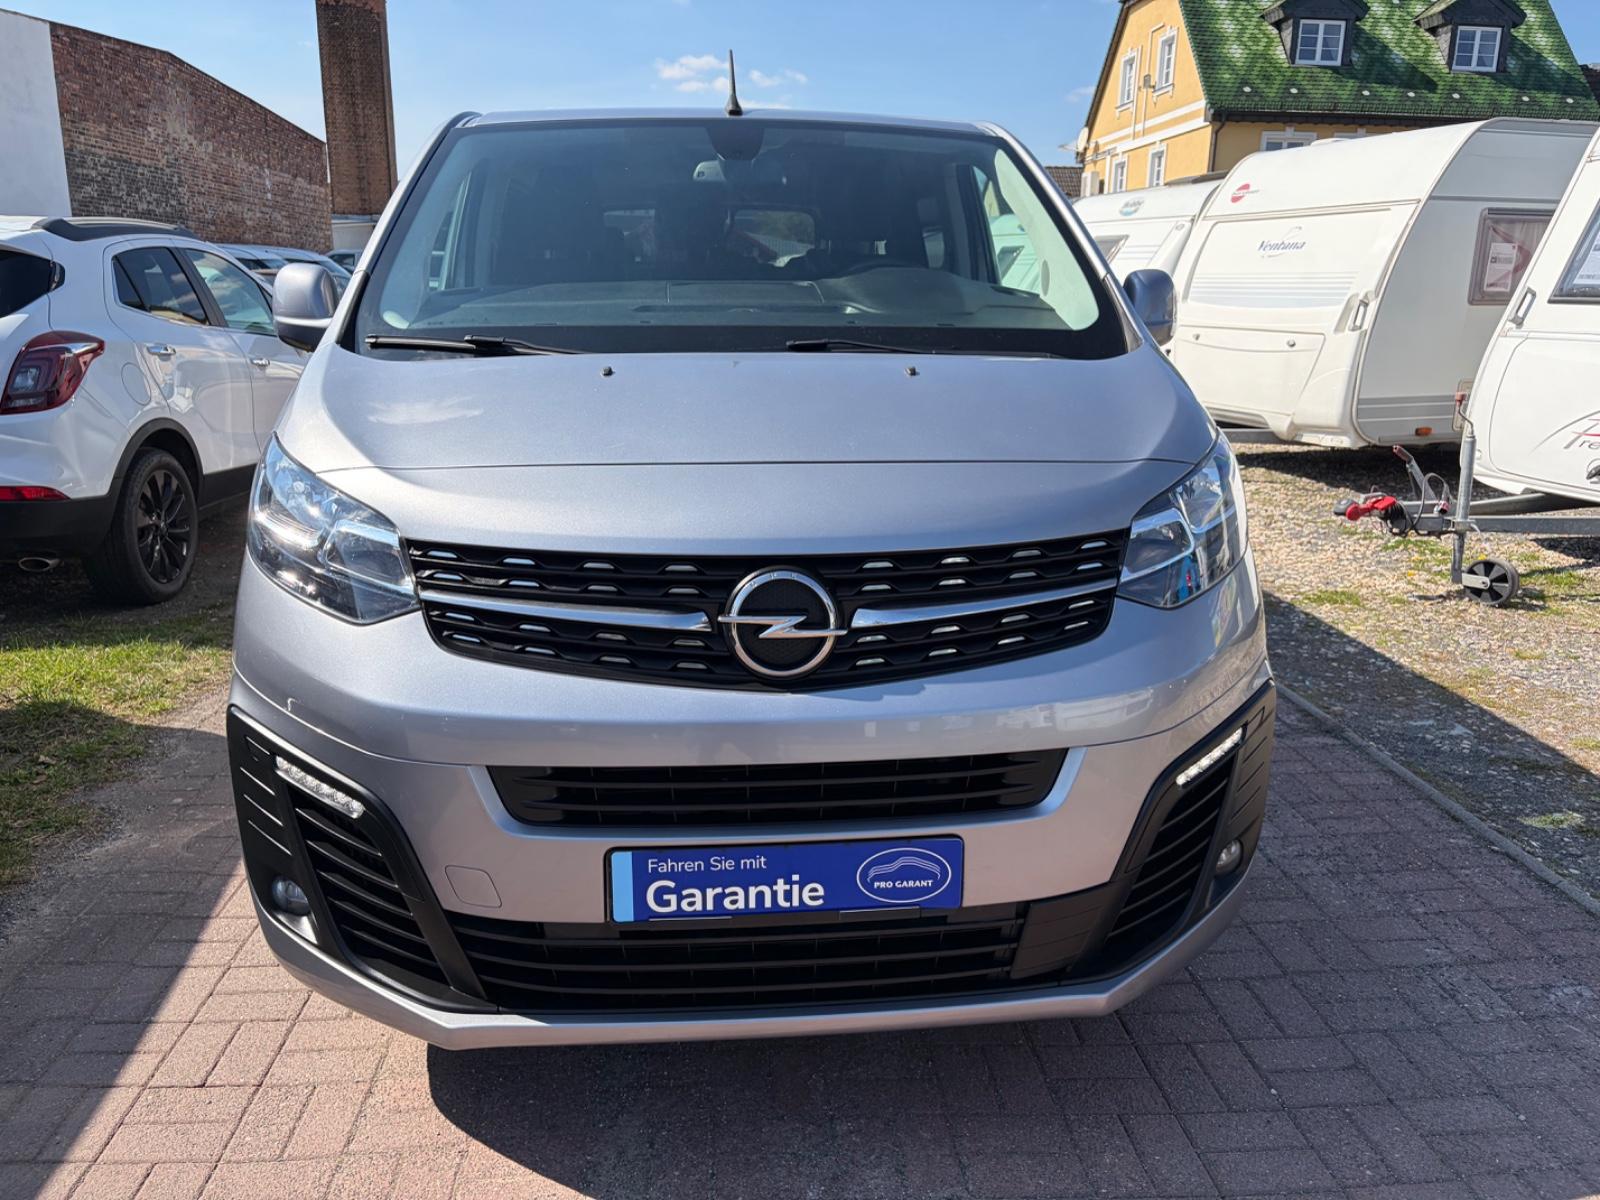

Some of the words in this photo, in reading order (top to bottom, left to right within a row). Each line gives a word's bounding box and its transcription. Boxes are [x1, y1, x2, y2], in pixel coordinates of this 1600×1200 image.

[1257, 240, 1307, 252] Ventana
[647, 858, 705, 874] Fahren
[709, 855, 735, 872] Sie
[740, 854, 767, 870] mit
[873, 881, 893, 889] PRO
[895, 880, 933, 888] GARANT
[645, 874, 826, 914] Garantie
